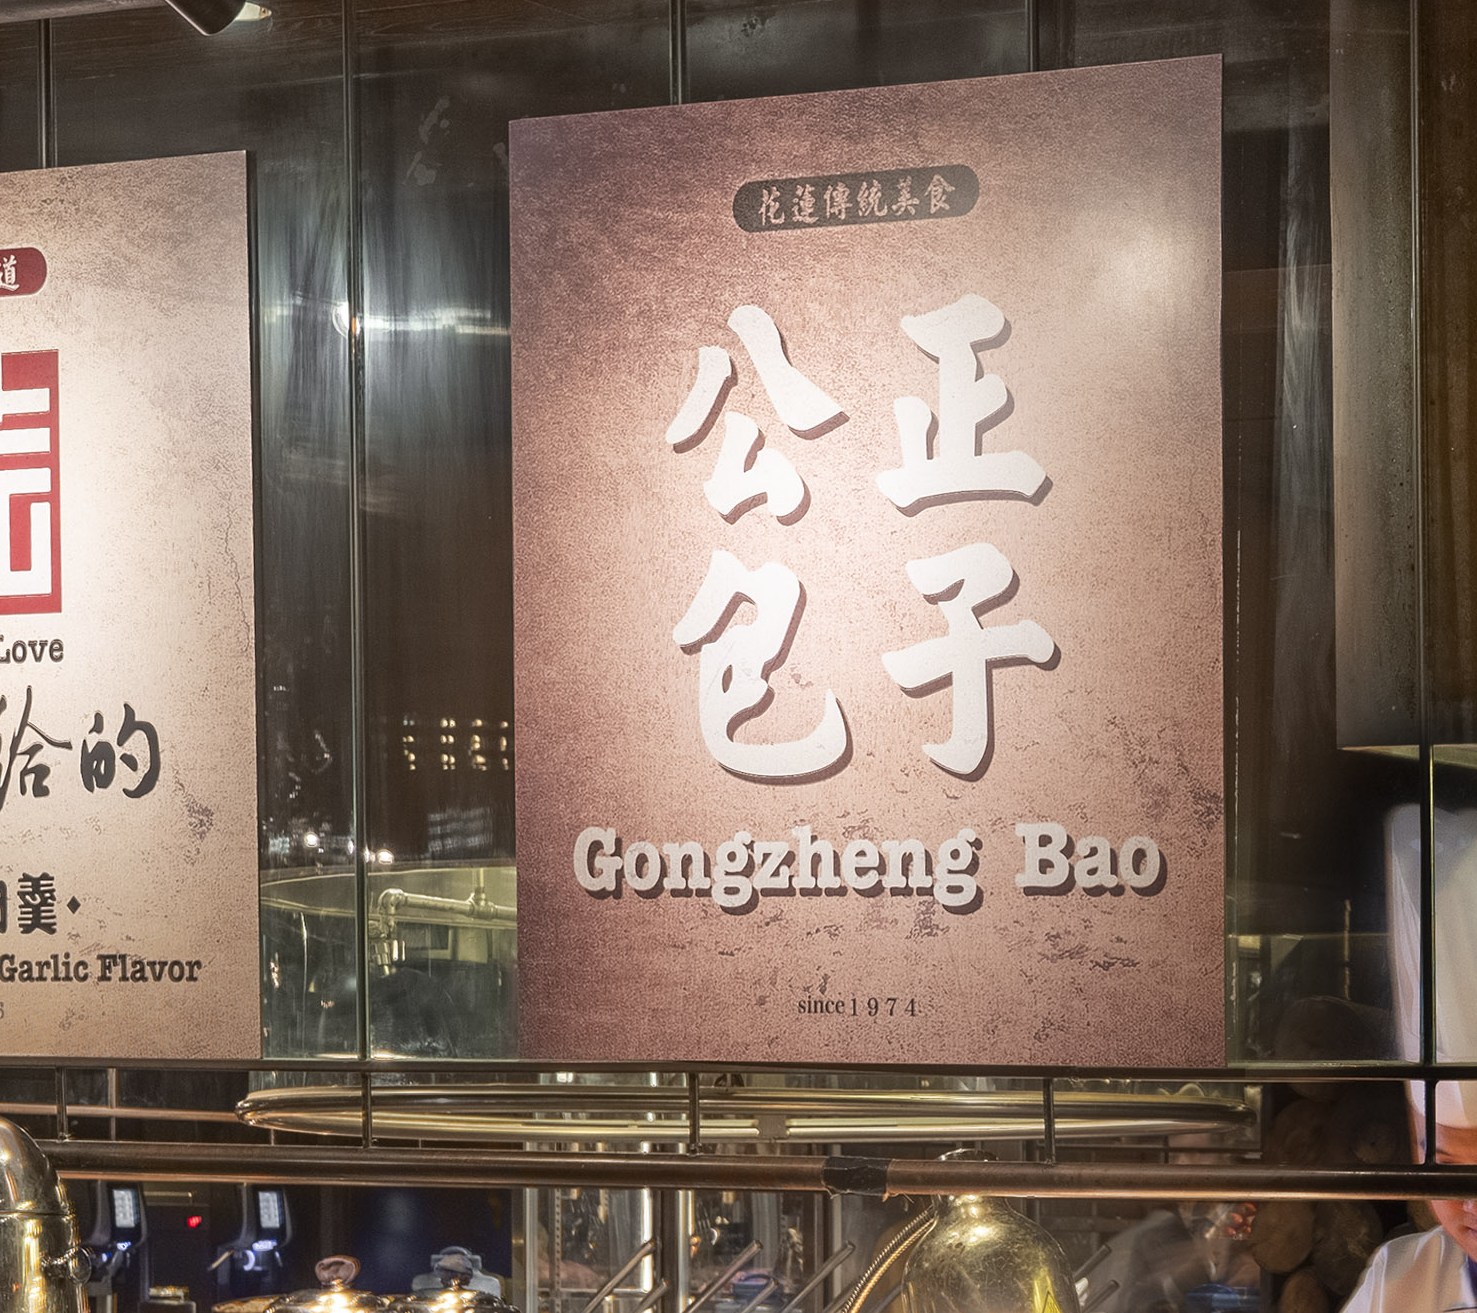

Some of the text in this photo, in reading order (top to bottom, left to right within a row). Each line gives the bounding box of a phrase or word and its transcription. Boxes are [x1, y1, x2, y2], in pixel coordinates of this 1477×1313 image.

[758, 174, 956, 226] 花蓮傳統美食
[572, 822, 1165, 911] Gongzheng Bao
[96, 952, 203, 983] Flavor
